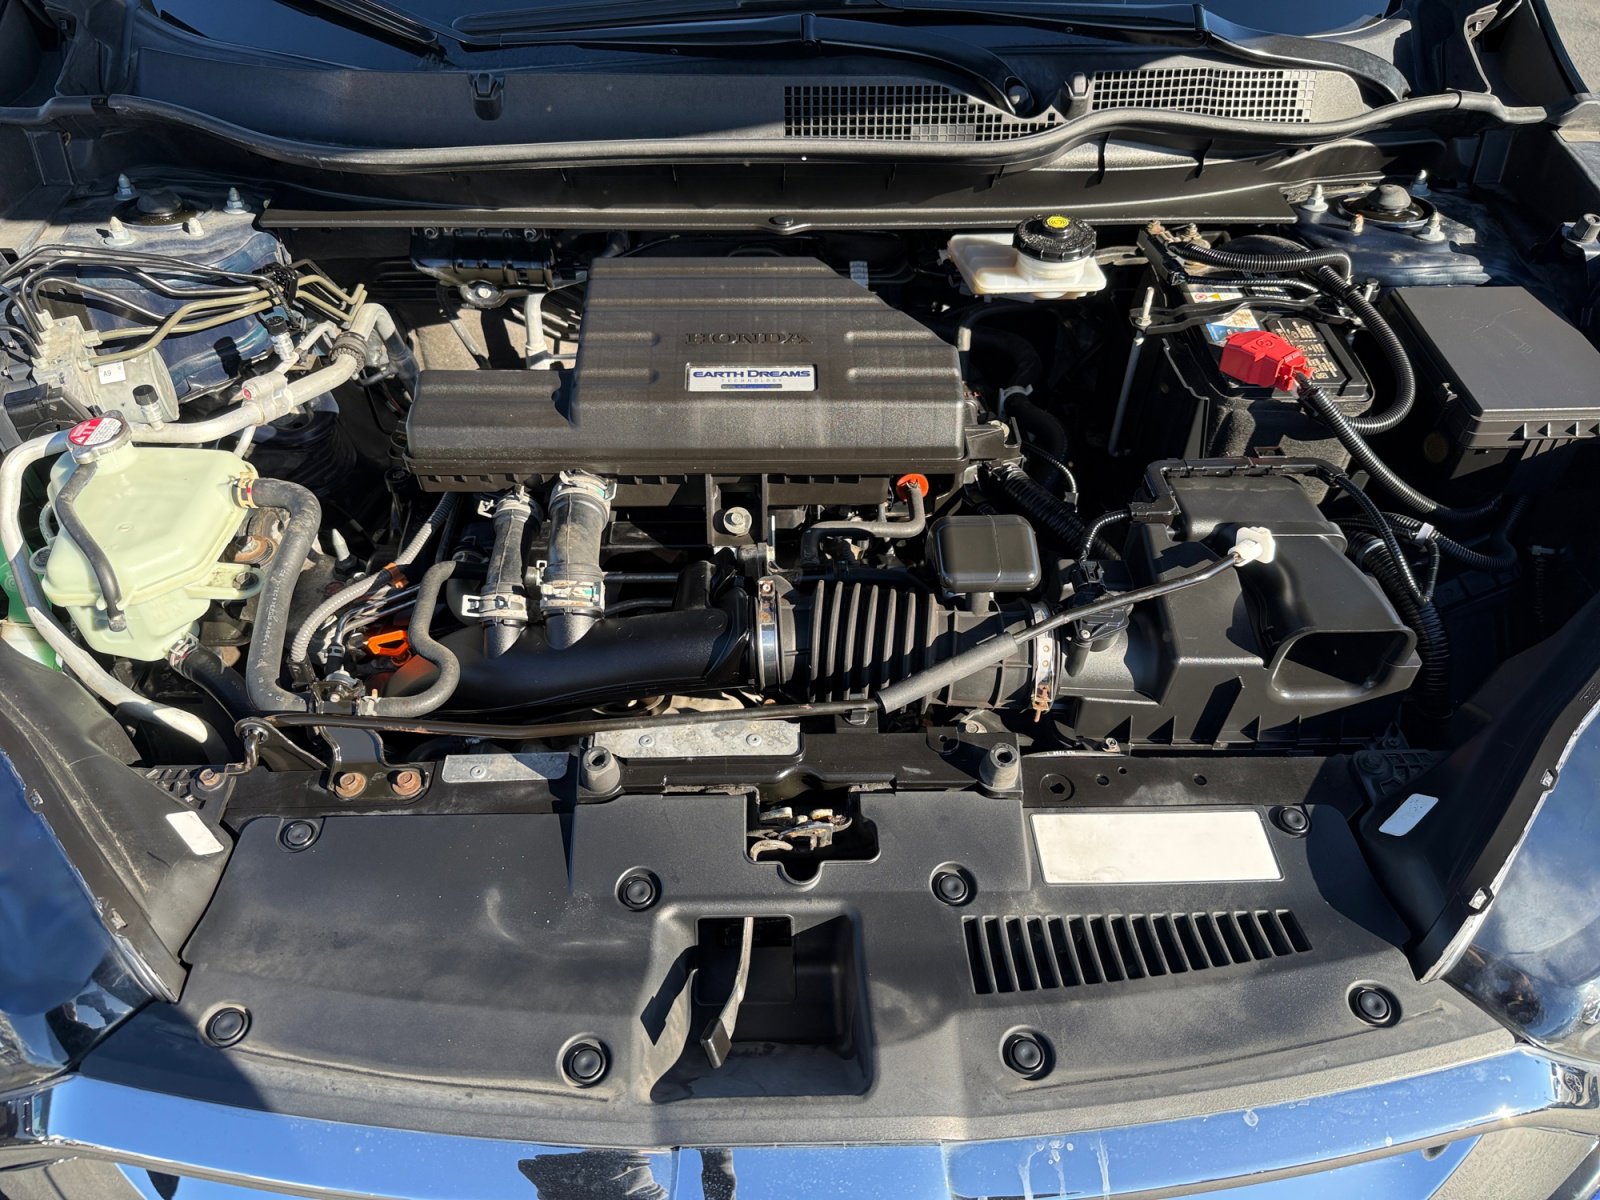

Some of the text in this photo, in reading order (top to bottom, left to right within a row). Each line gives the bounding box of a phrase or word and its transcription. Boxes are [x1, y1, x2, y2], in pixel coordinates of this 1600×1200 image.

[685, 332, 814, 345] HONDA
[692, 369, 811, 378] EARTH DREAMS
